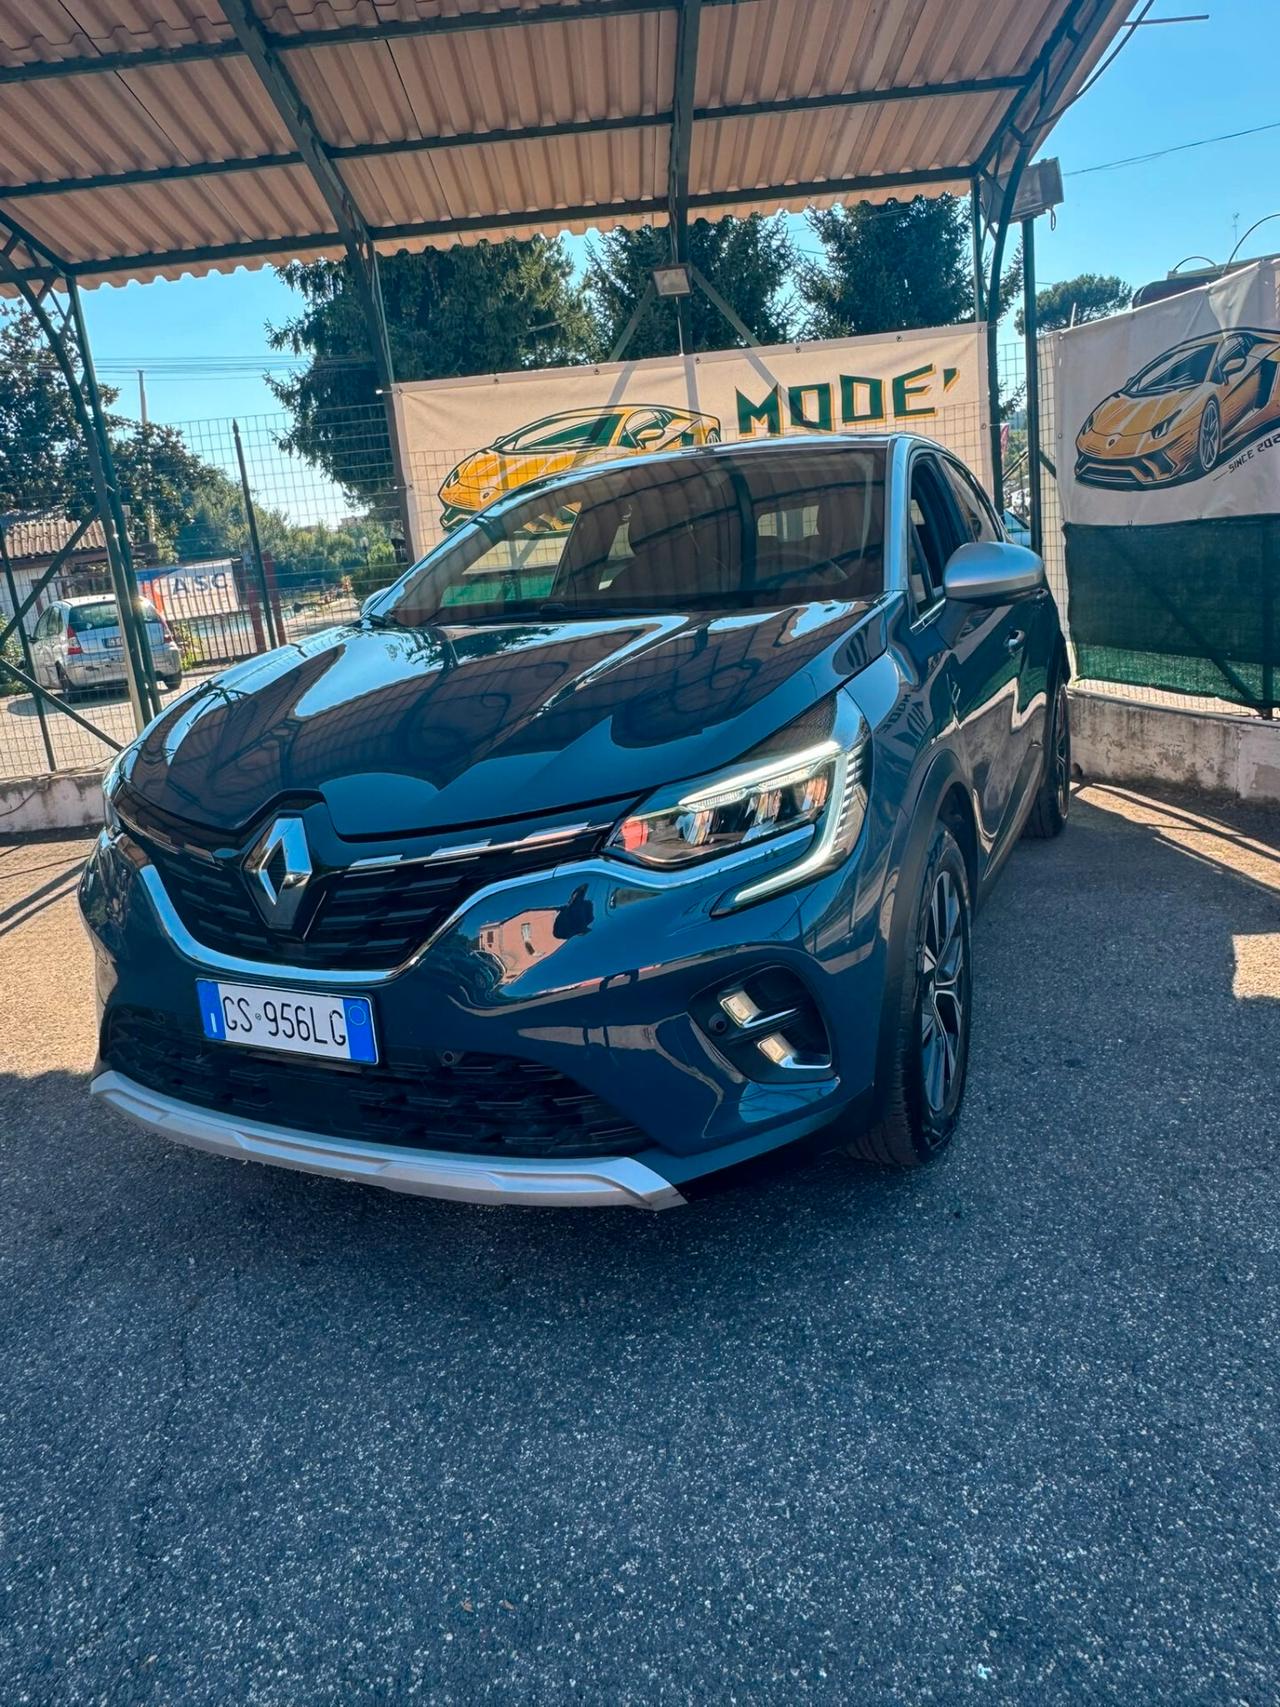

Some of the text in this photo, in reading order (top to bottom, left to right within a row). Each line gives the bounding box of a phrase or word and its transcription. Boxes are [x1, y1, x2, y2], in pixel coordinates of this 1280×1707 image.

[1228, 449, 1254, 473] SINCE
[222, 996, 347, 1047] GS 956LG
